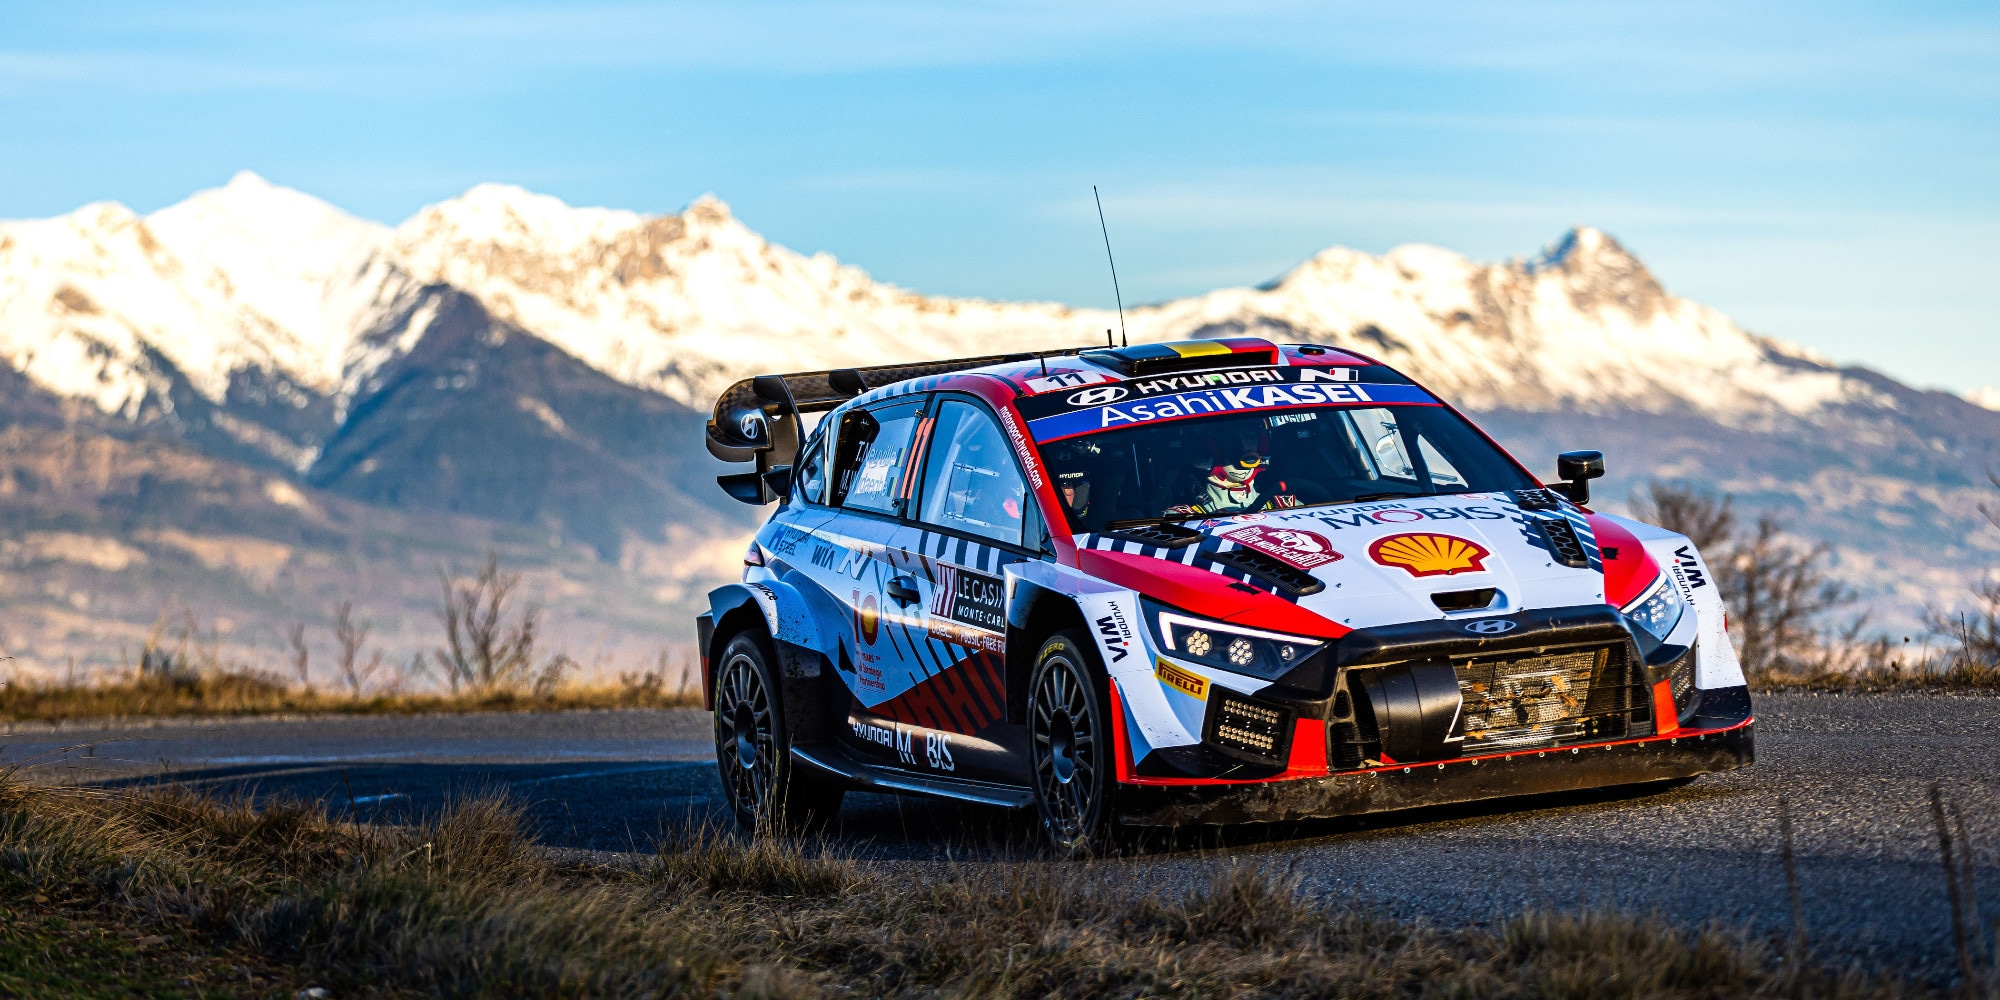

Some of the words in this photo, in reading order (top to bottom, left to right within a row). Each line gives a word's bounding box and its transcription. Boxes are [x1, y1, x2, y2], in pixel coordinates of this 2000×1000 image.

[1046, 373, 1087, 387] 11
[1135, 369, 1284, 395] HYUNDAI
[1000, 405, 1043, 490] motorsport.hyundai.com
[1279, 503, 1407, 521] HYUNDAI
[1318, 506, 1505, 530] MOBIS
[958, 575, 970, 600] LE
[1672, 565, 1696, 606] HYUNDAI
[1108, 600, 1132, 639] HYUNDAI
[1158, 661, 1204, 695] PIRELLI
[852, 720, 893, 748] HYUNDAI
[896, 728, 955, 772] MOBIS
